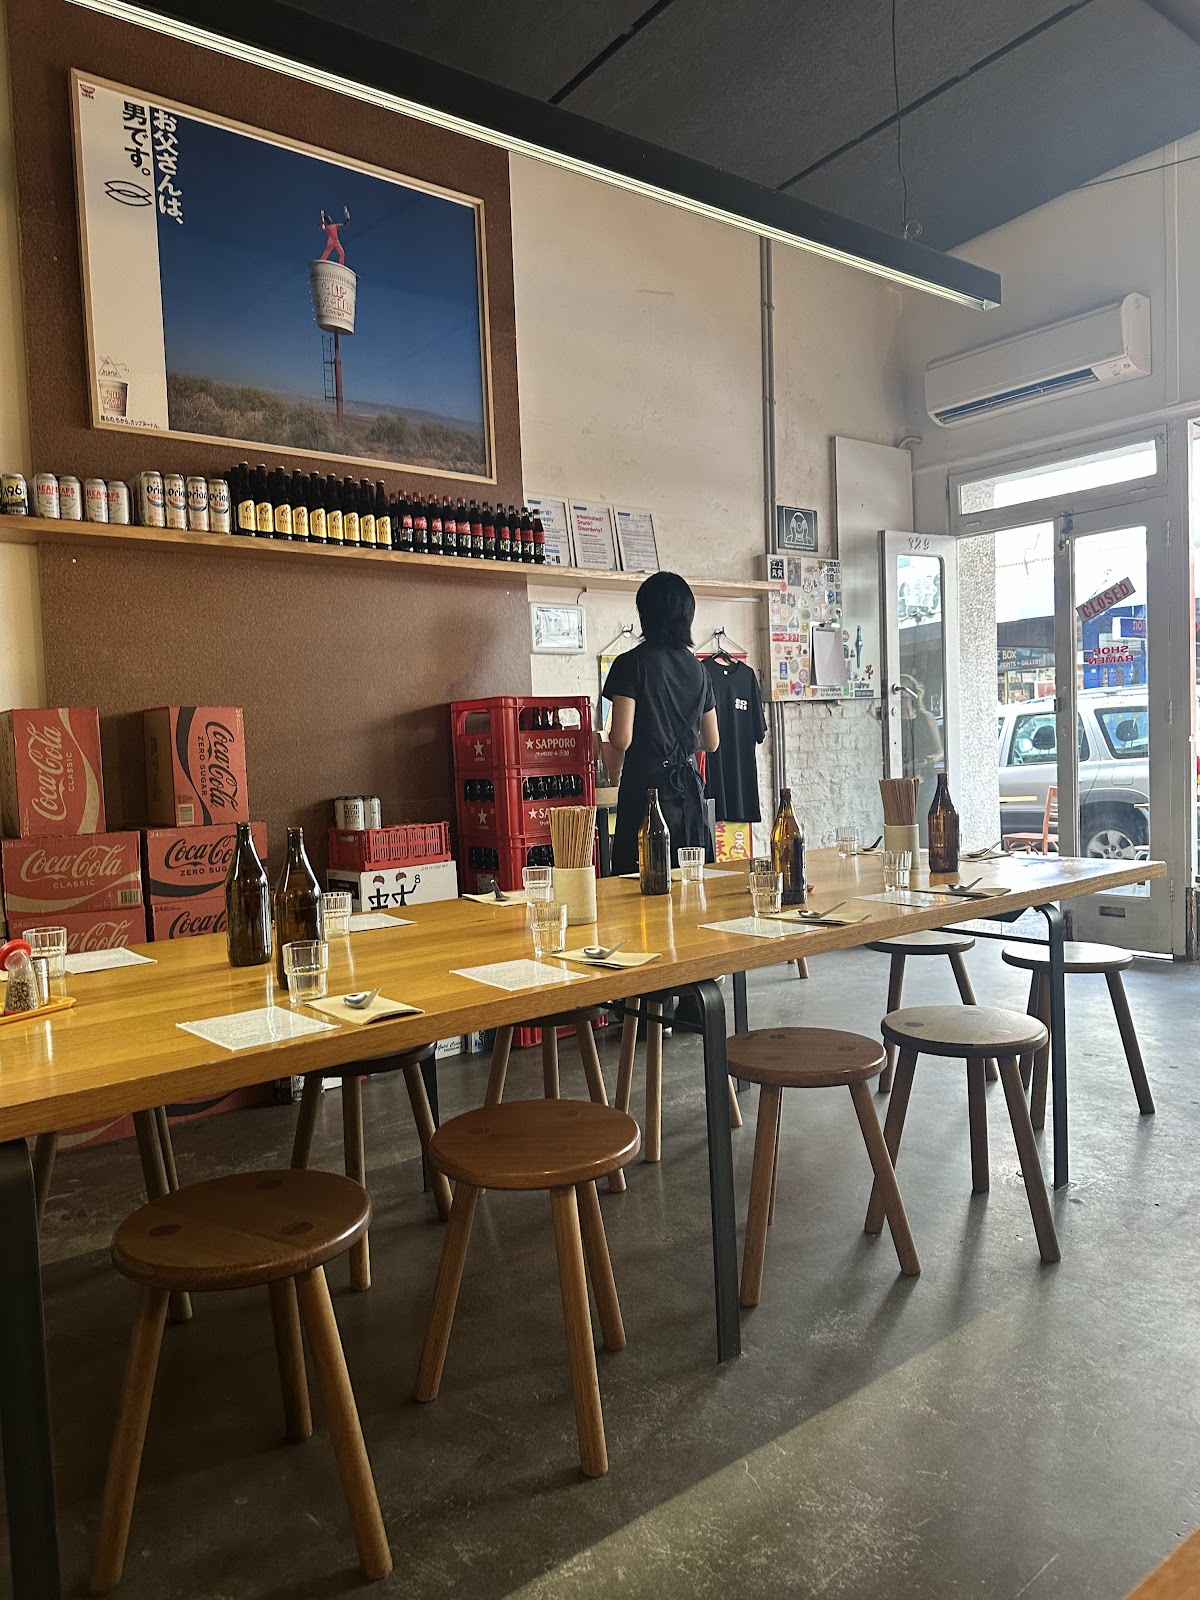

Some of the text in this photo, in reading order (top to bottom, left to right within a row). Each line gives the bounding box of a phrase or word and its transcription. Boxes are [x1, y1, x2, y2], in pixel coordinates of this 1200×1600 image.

[122, 100, 151, 176] 男です。
[153, 109, 184, 225] お父さんは、
[168, 488, 185, 498] Orio
[1081, 582, 1130, 619] CLOSED
[1002, 650, 1017, 660] BOX
[1020, 658, 1041, 666] GALLERY
[535, 737, 576, 749] SAPPORO
[27, 720, 67, 821] Coca-Cola
[199, 764, 208, 797] SUGAR
[205, 721, 239, 812] Coca-Cola
[21, 844, 127, 882] Coca-Cola
[164, 834, 238, 869] Coca-Co
[53, 879, 96, 889] CLASSIC
[180, 865, 228, 877] ZERO SUG
[67, 919, 134, 952] a-Cola
